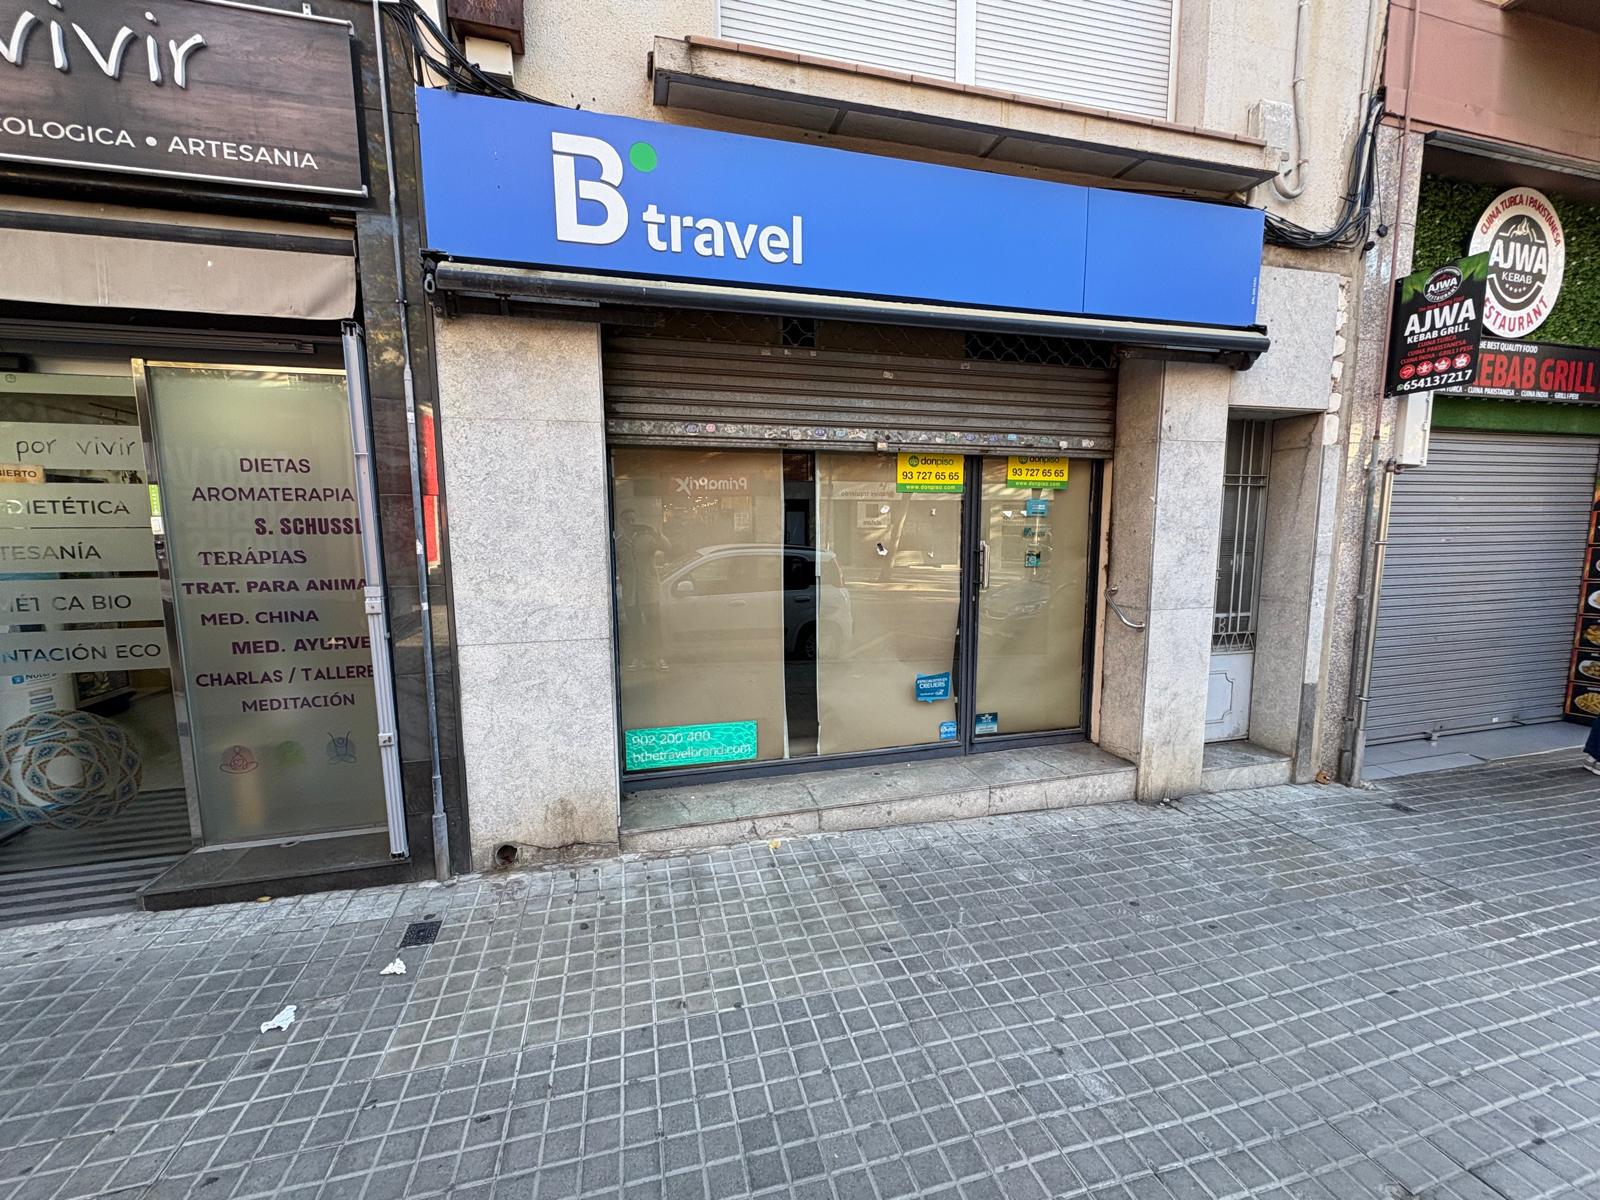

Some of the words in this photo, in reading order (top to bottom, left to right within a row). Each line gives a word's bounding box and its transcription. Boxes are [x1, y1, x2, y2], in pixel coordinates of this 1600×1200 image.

[0, 116, 135, 149] OLOGICA
[167, 135, 319, 171] ARTESANIA
[551, 131, 629, 245] B
[1480, 205, 1502, 235] CUINA
[642, 204, 803, 265] travel
[1489, 239, 1547, 275] AJWA
[1427, 277, 1458, 293] AJWA
[1501, 271, 1533, 285] KEBAB
[1403, 298, 1476, 336] AJWA
[1406, 329, 1439, 344] KEBAB
[1440, 322, 1470, 337] GRILL
[1487, 341, 1500, 350] BEST
[1500, 342, 1523, 352] QUALITY
[1522, 344, 1539, 354] FOOD
[1403, 369, 1473, 391] 654137217
[1473, 352, 1537, 389] EBAB
[1539, 358, 1596, 393] GRILL
[16, 438, 57, 461] por
[76, 437, 136, 456] vivir
[239, 458, 311, 474] DIETAS
[921, 456, 954, 467] donpiso
[902, 470, 914, 480] 93
[916, 471, 932, 480] 727
[935, 471, 946, 481] 65
[949, 471, 960, 481] 65
[1012, 467, 1023, 477] 93
[1025, 468, 1040, 477] 727
[1042, 469, 1052, 477] 65
[1054, 469, 1065, 477] 65
[192, 486, 355, 502] AROMATERAPIA
[6, 496, 130, 515] DIETÉTICA
[255, 517, 274, 536] S.
[198, 547, 308, 566] TERÁPIAS
[181, 581, 240, 595] TRAT.
[246, 580, 300, 593] PARA
[306, 578, 366, 592] ANIMA
[93, 594, 132, 611] BIO
[200, 612, 250, 626] MED.
[255, 609, 319, 625] CHINA
[116, 643, 161, 660] ECO
[231, 639, 286, 655] MED.
[293, 635, 371, 652] AYURVE
[195, 669, 284, 687] CHARLAS
[301, 664, 374, 681] TALLERE
[241, 691, 355, 713] MEDITACIÓN
[631, 735, 656, 747] 902
[660, 732, 684, 745] 200
[686, 730, 711, 742] 400
